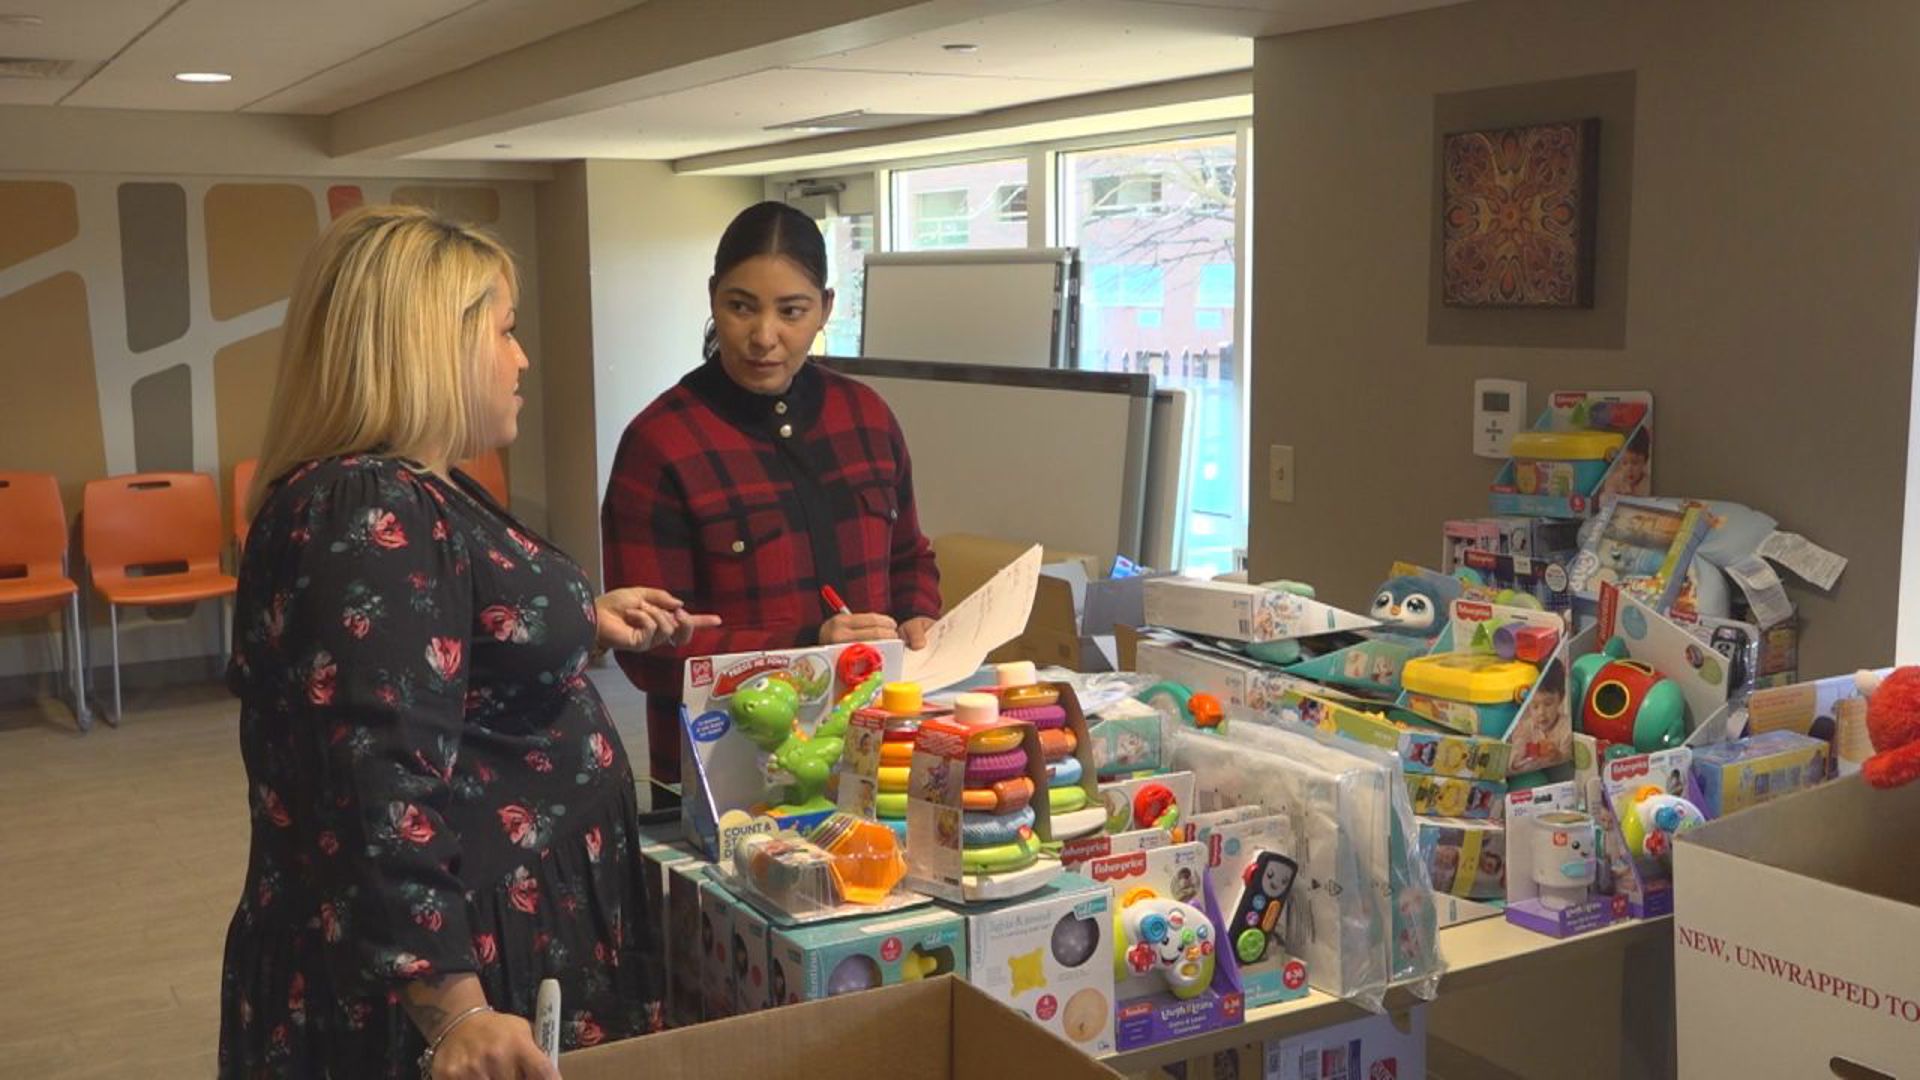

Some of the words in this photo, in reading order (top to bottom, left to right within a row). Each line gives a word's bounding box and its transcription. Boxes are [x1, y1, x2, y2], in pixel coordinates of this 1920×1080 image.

[724, 822, 763, 838] COUNT
[1679, 927, 1730, 963] NEW,
[1734, 945, 1880, 1010] UNWRAPPED
